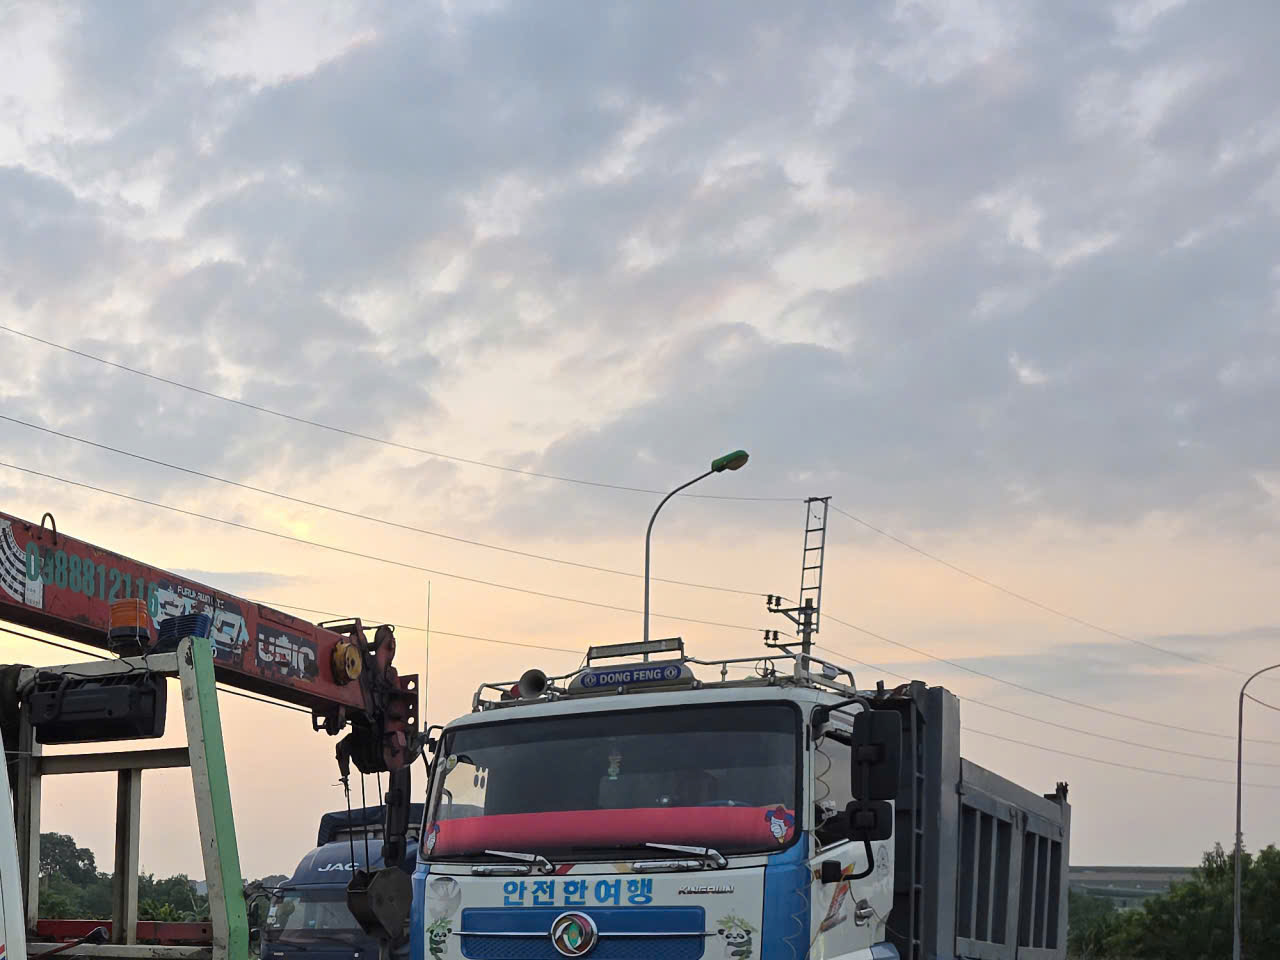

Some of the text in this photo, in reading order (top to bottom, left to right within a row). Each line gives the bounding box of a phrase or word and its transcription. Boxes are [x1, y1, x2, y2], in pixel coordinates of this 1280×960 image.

[599, 669, 661, 684] DONG FENG
[318, 862, 359, 872] JAC
